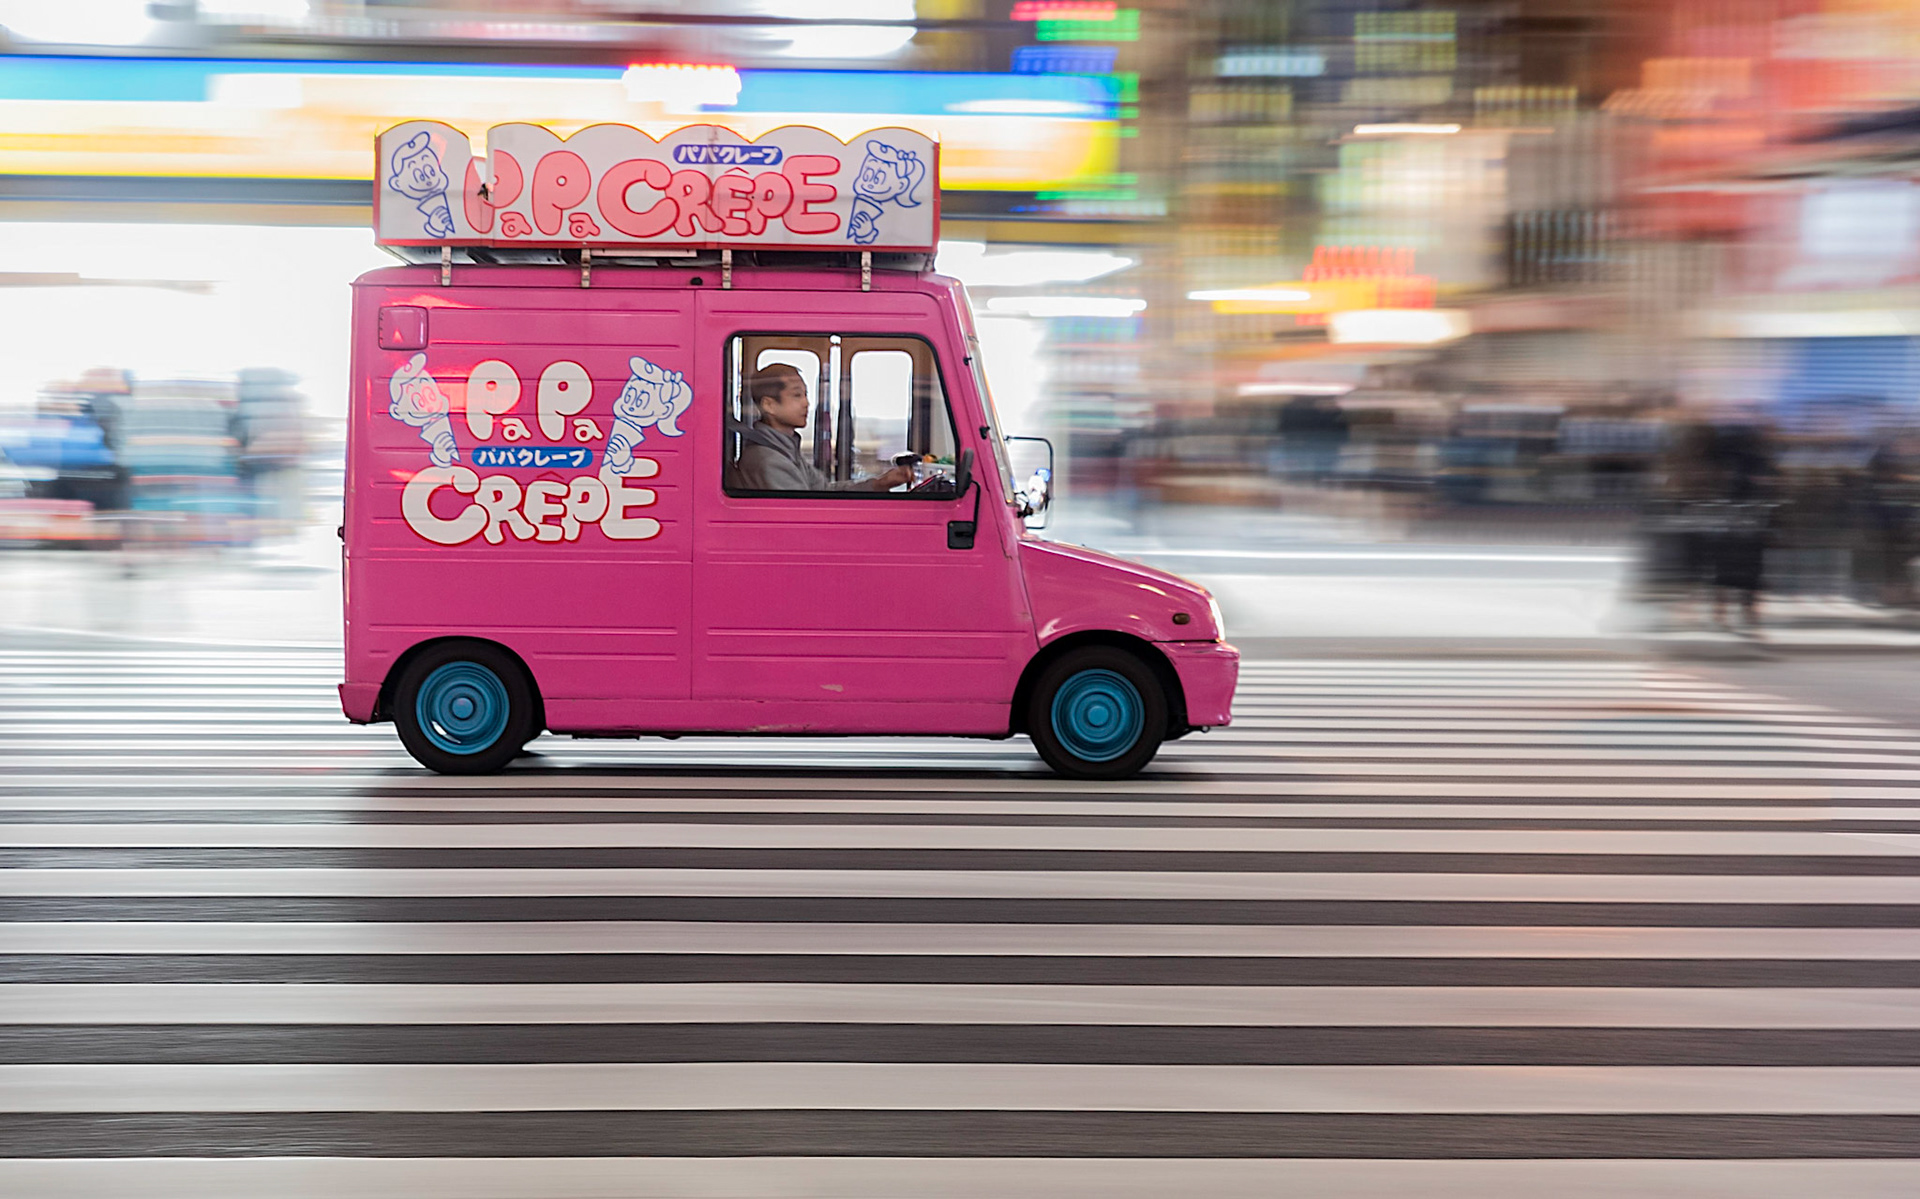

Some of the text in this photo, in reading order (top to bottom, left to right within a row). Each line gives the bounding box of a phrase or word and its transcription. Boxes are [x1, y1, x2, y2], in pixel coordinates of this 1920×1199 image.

[678, 146, 779, 164] パパクレープ
[466, 360, 603, 442] PaPa
[478, 448, 586, 467] パパクレープ
